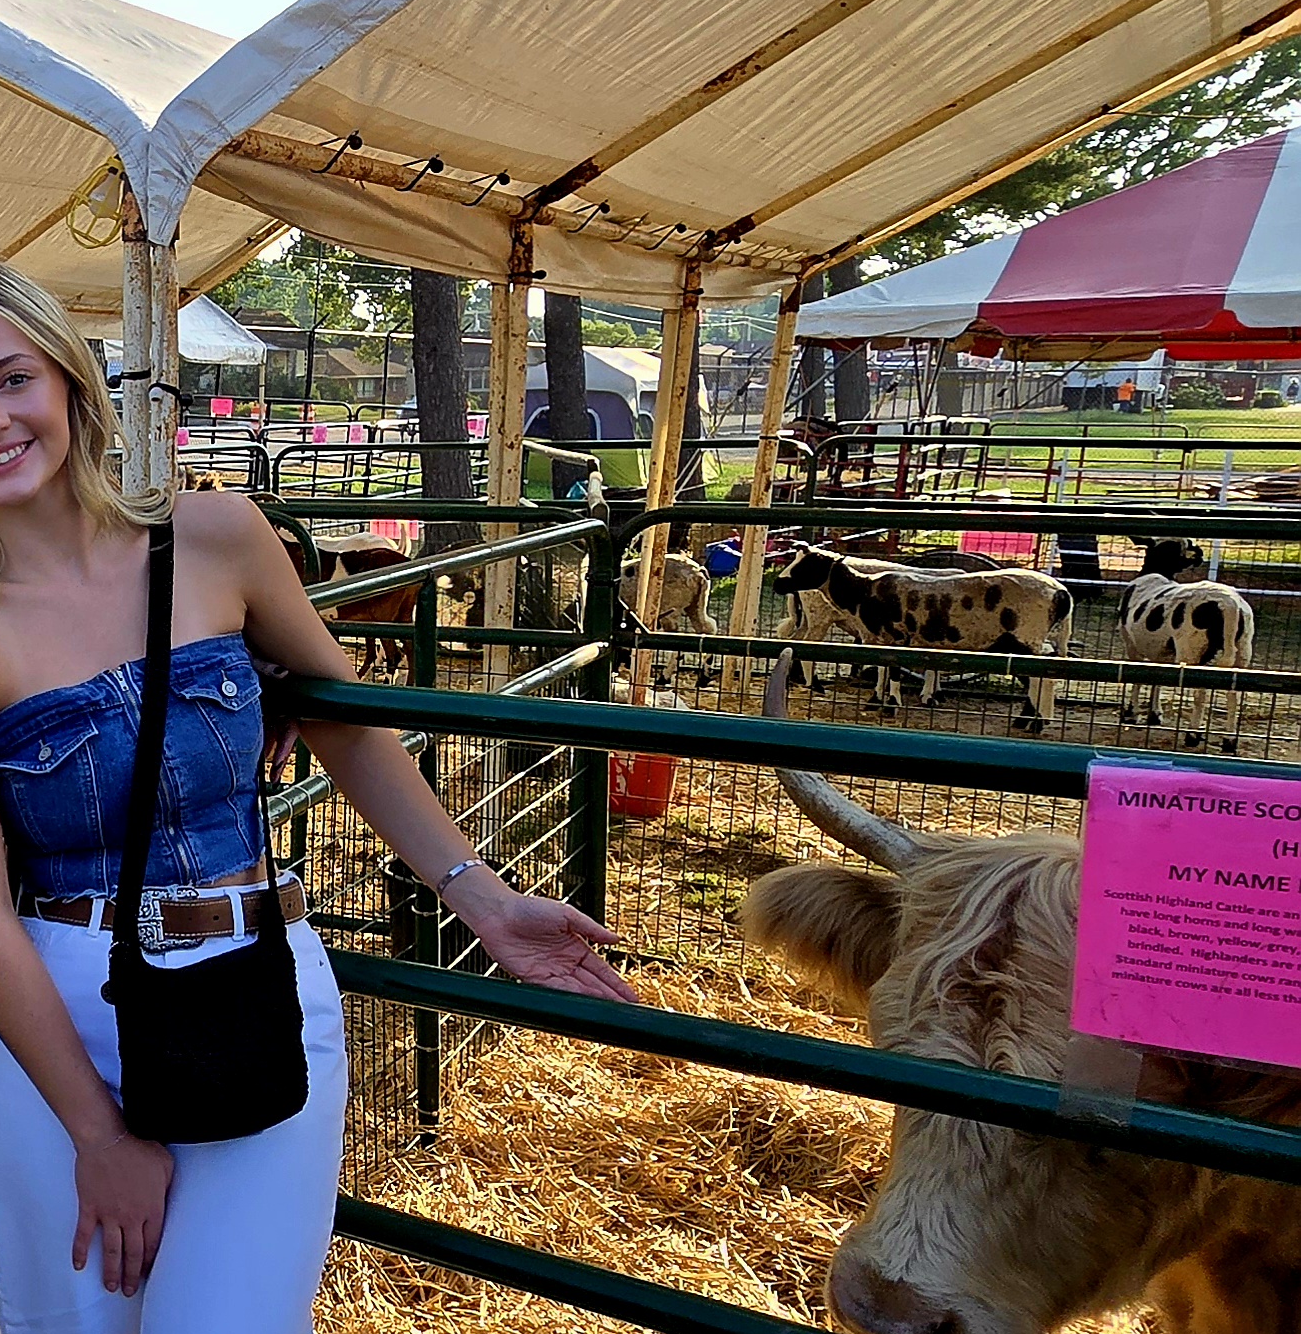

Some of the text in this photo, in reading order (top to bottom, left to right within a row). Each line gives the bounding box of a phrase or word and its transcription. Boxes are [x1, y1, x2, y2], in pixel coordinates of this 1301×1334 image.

[1117, 790, 1248, 816] MINATURE
[1168, 865, 1291, 892] MY NAME
[1104, 889, 1153, 903] Scottish
[1156, 895, 1213, 909] Highland
[1216, 902, 1255, 914] Cattle
[1257, 907, 1280, 918] are
[1120, 906, 1150, 919] have
[1153, 910, 1181, 924] long
[1184, 914, 1221, 927] horns
[1223, 919, 1249, 931] and
[1252, 922, 1281, 936] long
[1128, 923, 1165, 937] black,
[1168, 928, 1214, 944] brown,
[1115, 954, 1173, 970] Standard
[1175, 963, 1239, 979] miniature
[1241, 972, 1276, 984] cows
[1127, 939, 1295, 971] brindled. Highlanders are
[1111, 971, 1173, 986] miniature
[1175, 979, 1208, 992] cows
[1210, 984, 1233, 995] are
[1234, 987, 1252, 998] all
[1254, 989, 1280, 1002] less
